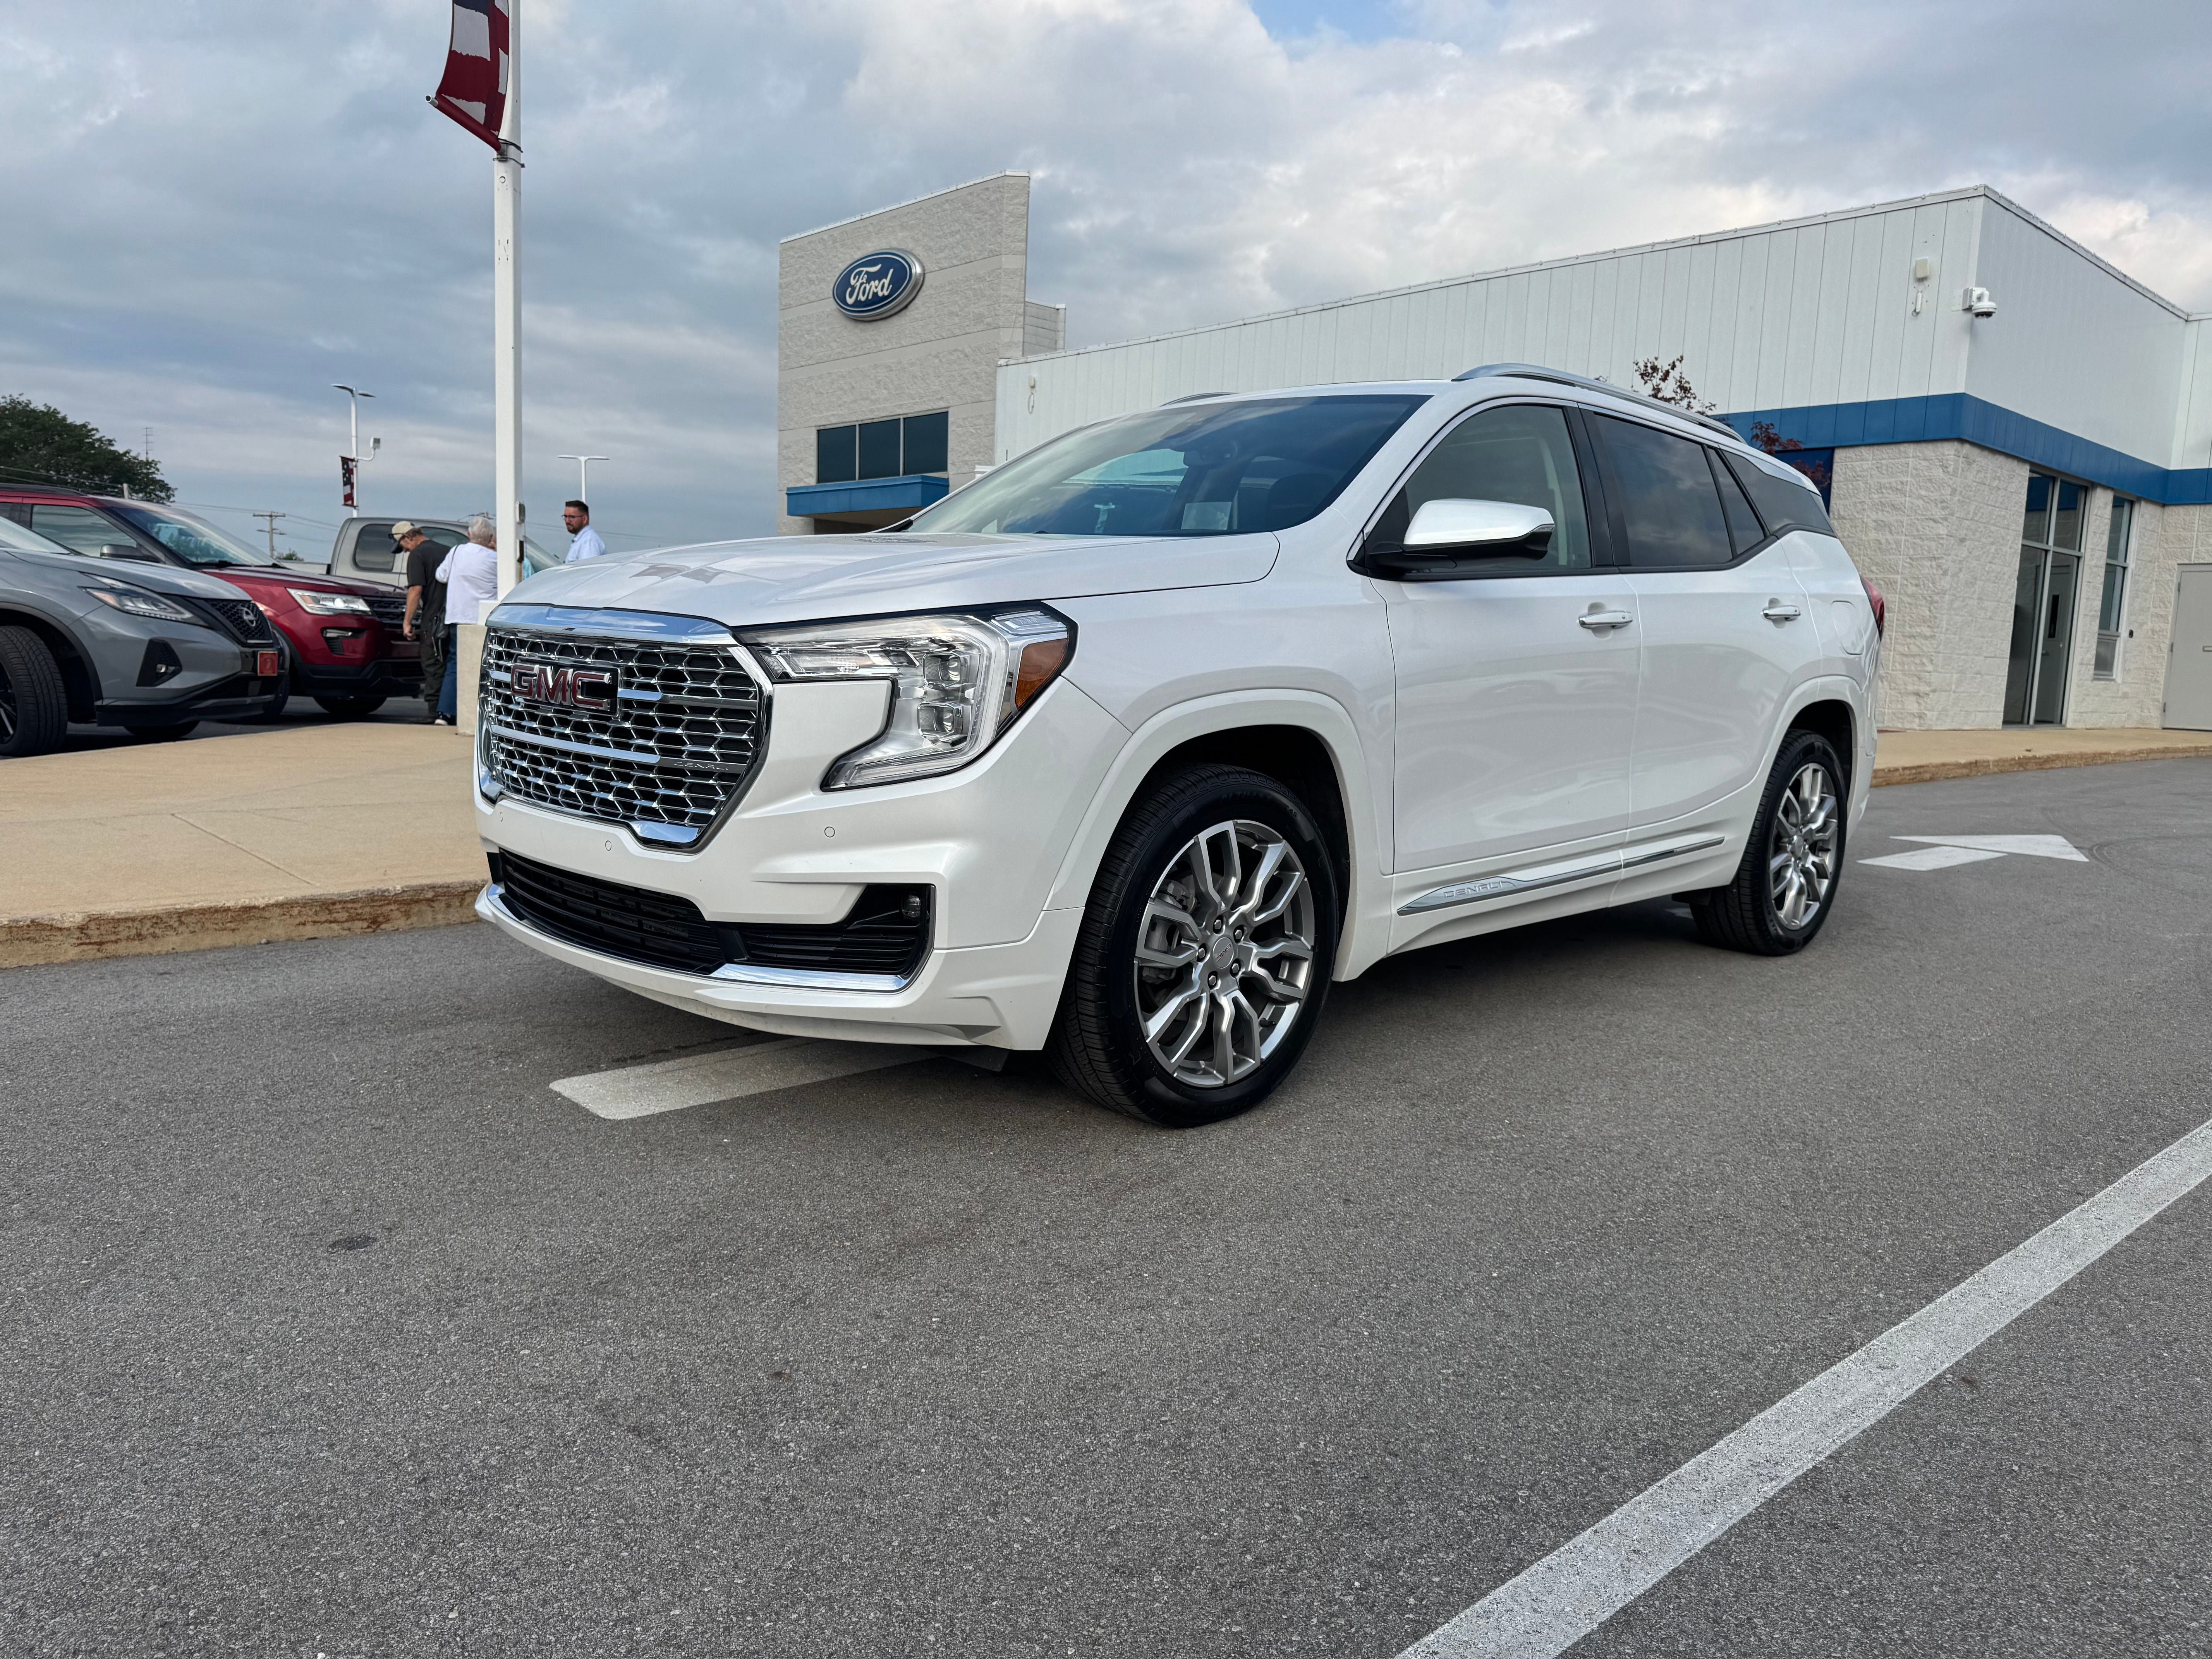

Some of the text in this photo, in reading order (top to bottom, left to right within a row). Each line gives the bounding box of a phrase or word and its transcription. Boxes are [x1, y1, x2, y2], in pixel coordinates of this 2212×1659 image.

[846, 260, 894, 305] Ford
[511, 663, 611, 711] GMC
[674, 761, 728, 770] DENALI
[1443, 880, 1503, 898] DENALI
[1215, 943, 1231, 962] GMC
